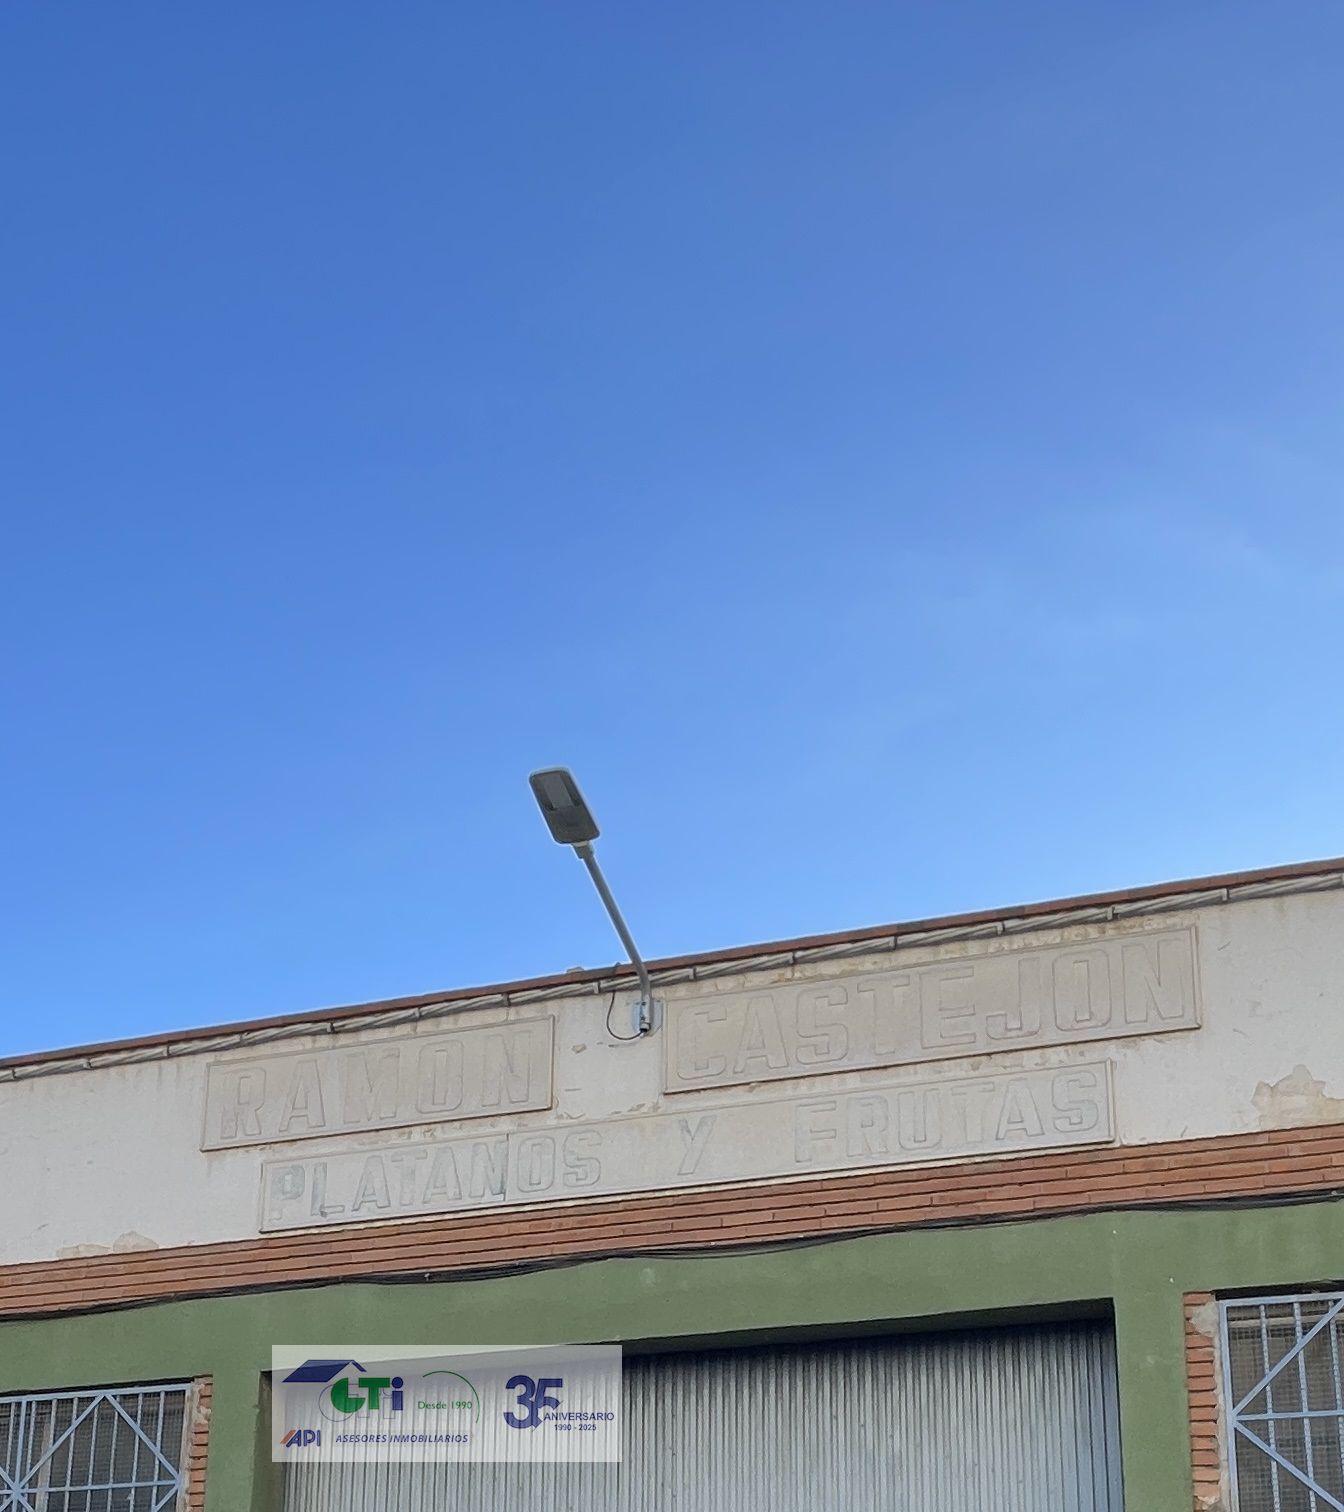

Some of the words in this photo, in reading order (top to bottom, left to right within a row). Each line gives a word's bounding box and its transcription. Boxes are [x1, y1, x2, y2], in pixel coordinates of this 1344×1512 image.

[220, 1030, 534, 1140] RAMON
[676, 937, 1194, 1081] CASTEJON
[269, 1126, 601, 1223] PLATANOS
[677, 1114, 718, 1176] Y
[794, 1070, 1100, 1164] FRUTAS
